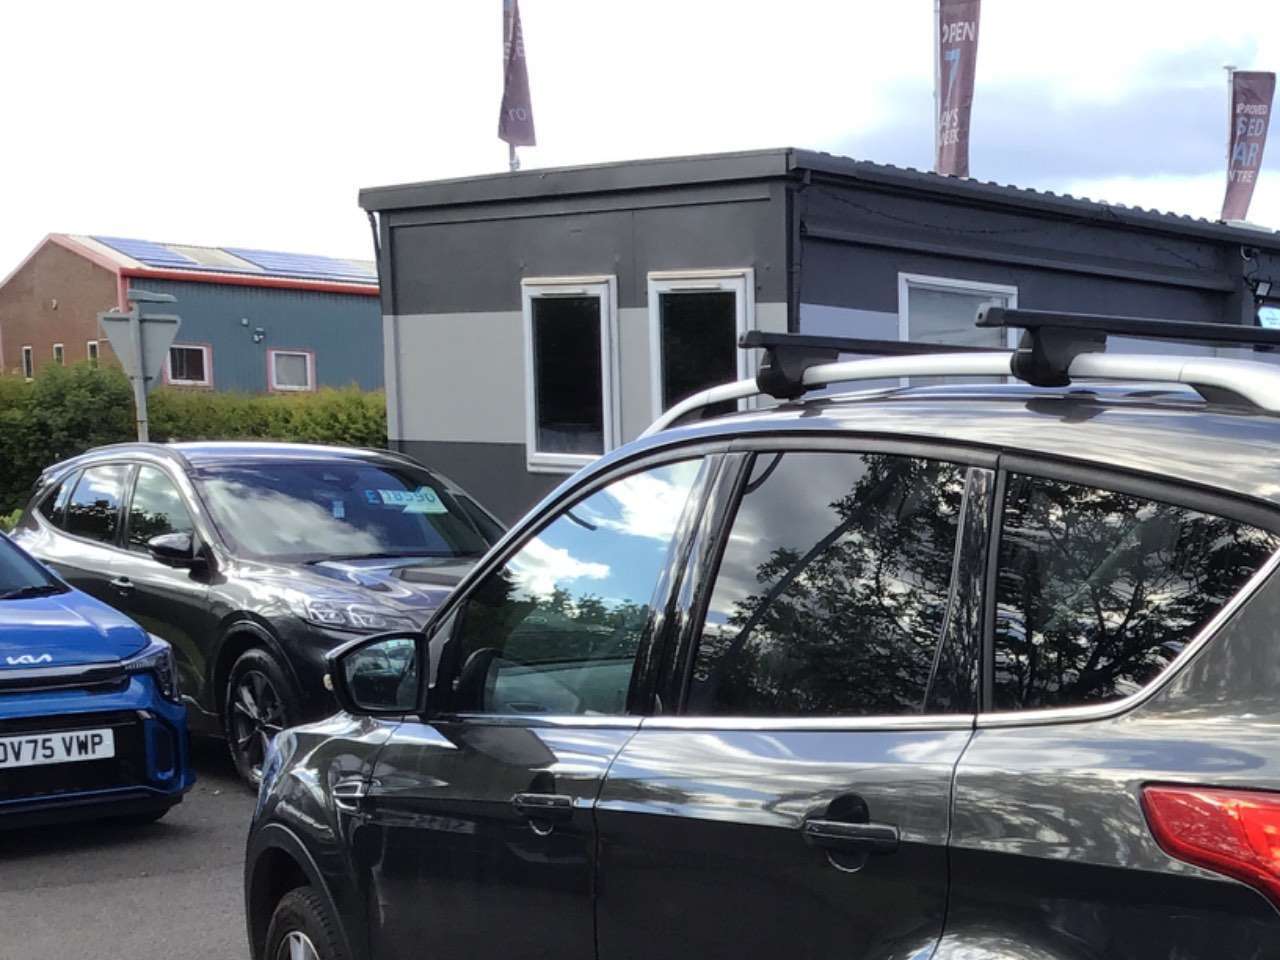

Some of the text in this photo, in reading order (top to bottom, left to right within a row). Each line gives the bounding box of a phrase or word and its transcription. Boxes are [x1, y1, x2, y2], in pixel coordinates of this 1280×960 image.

[1236, 116, 1266, 137] SED
[1231, 142, 1260, 167] AR
[62, 733, 104, 757] VWP
